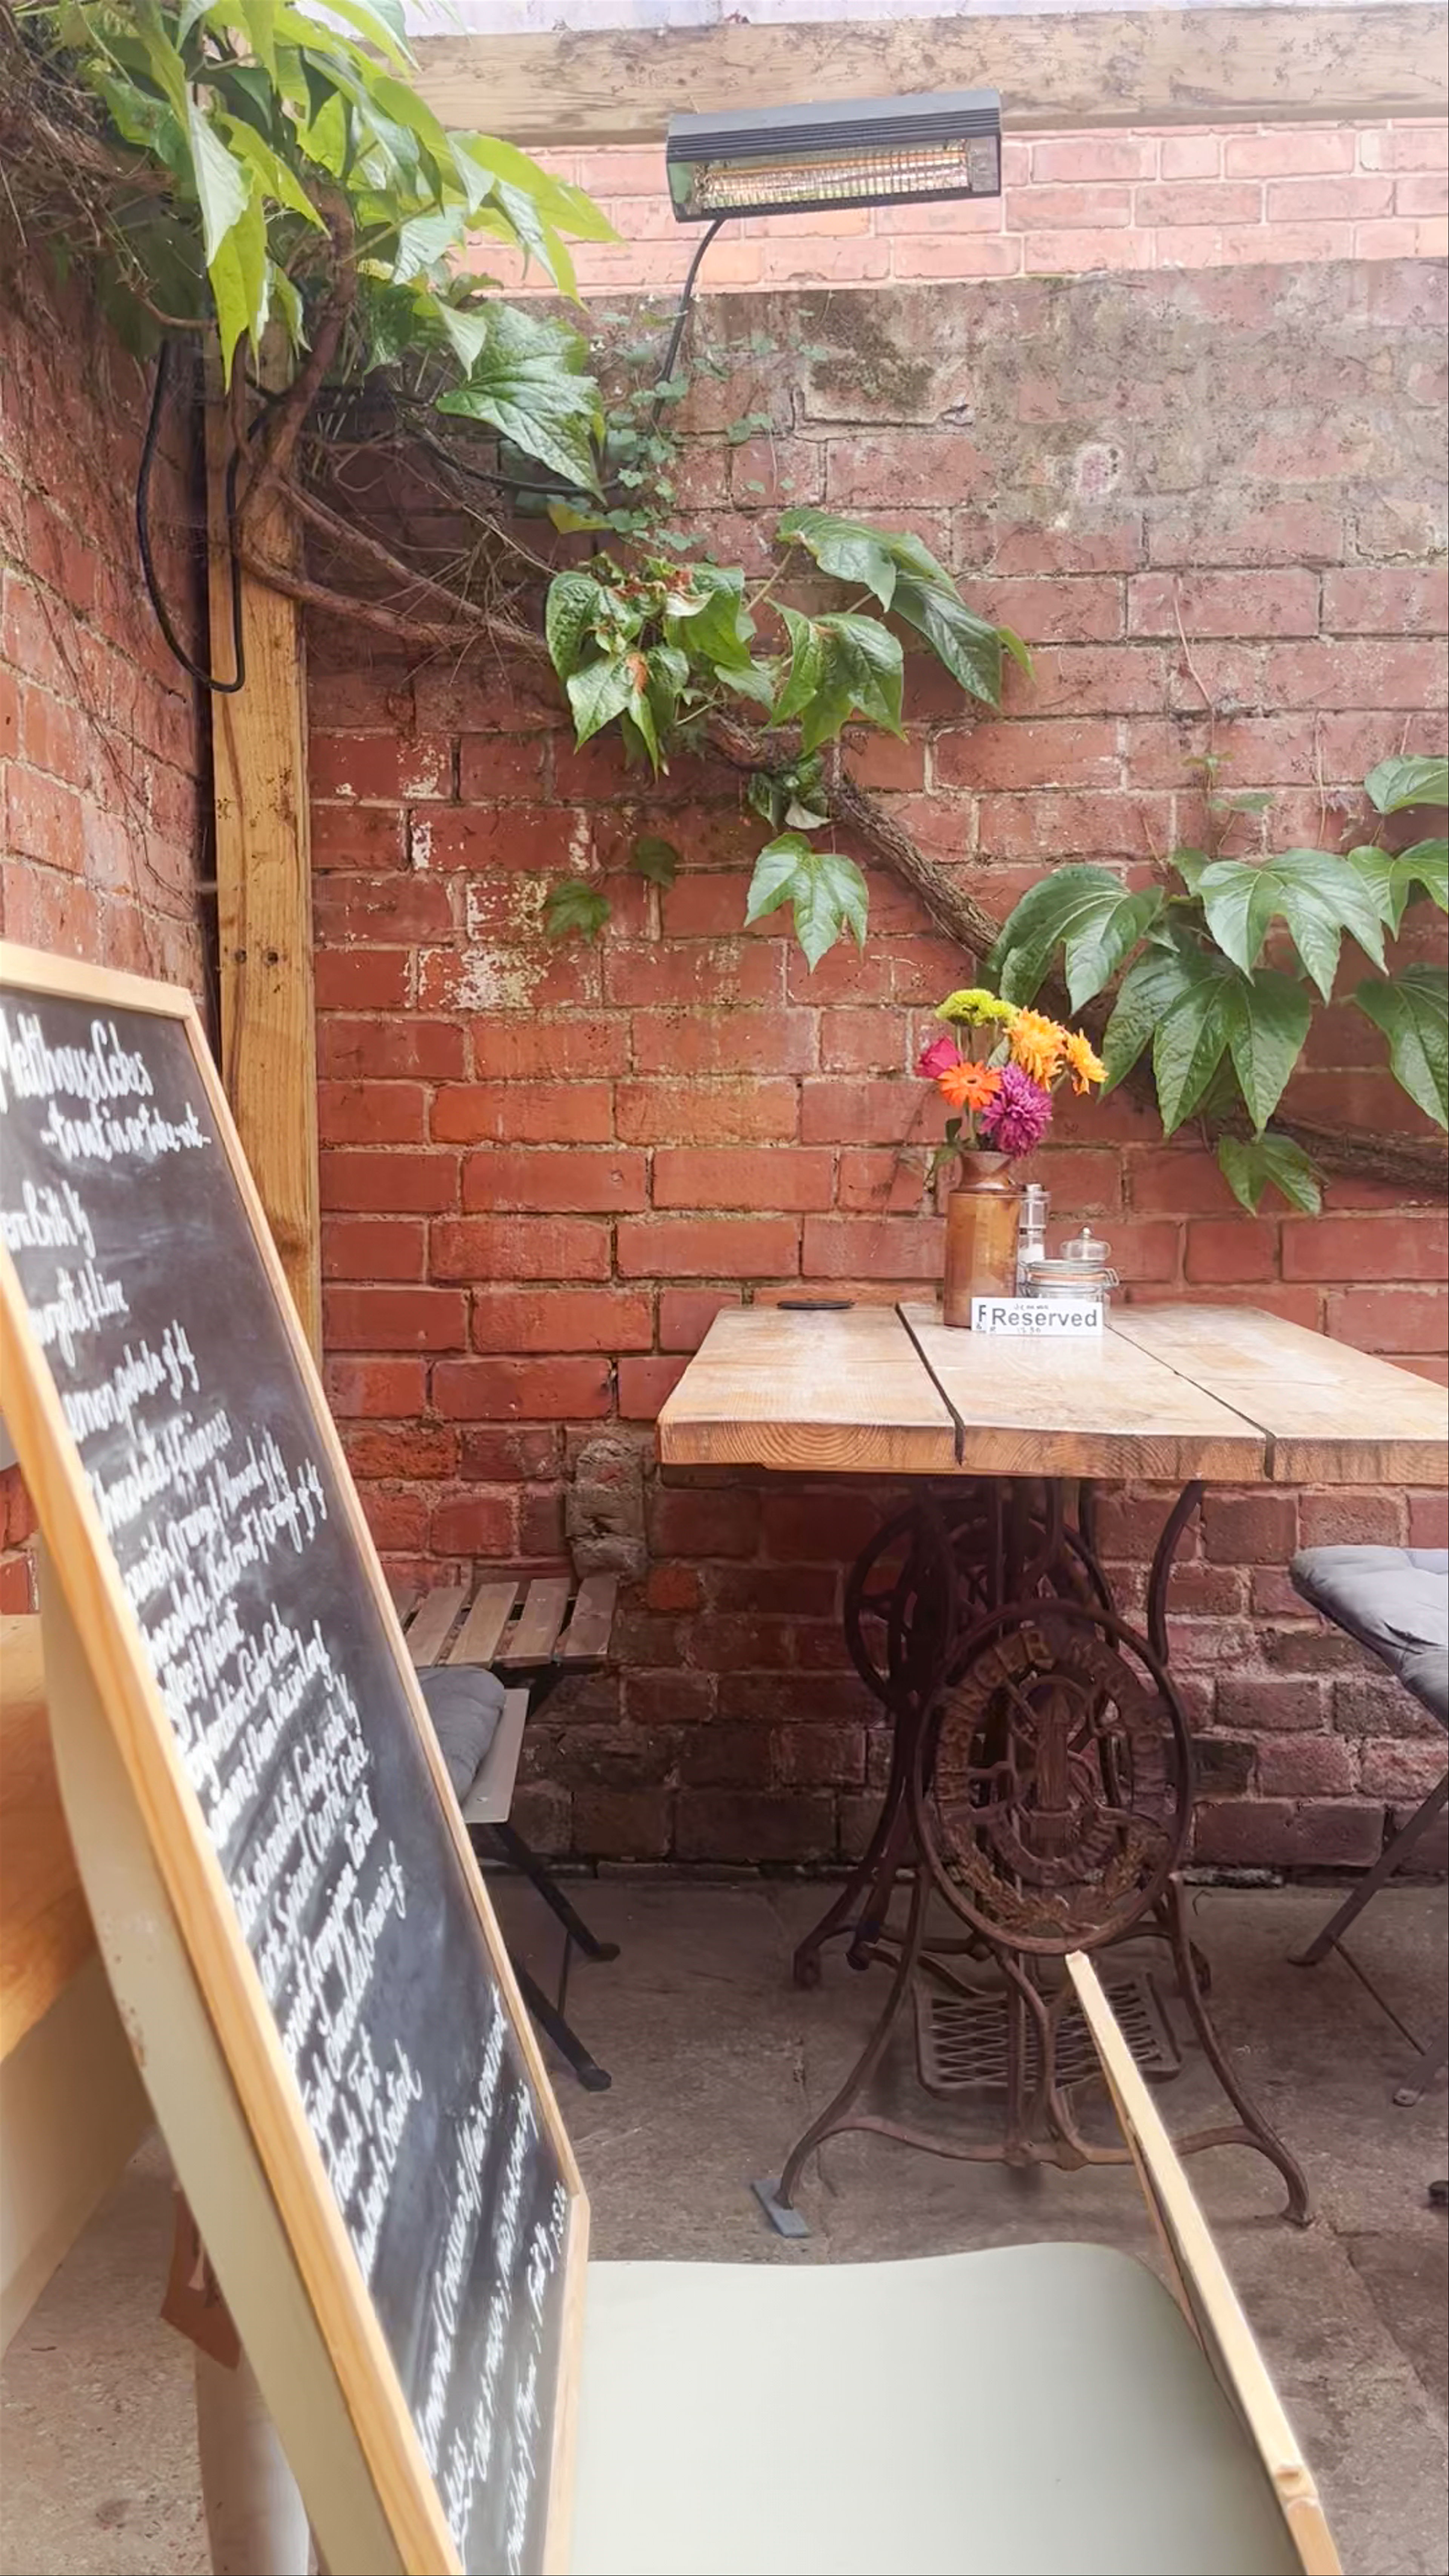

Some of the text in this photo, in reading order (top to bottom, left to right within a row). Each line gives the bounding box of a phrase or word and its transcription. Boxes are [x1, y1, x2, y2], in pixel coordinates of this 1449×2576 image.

[92, 1021, 153, 1097] Cakes
[75, 1100, 112, 1161] eat
[102, 1106, 130, 1153] in
[0, 1212, 36, 1250] ara
[27, 1268, 90, 1368] ourgette
[85, 1258, 129, 1316] Lime
[992, 1308, 1097, 1327] Reserved
[63, 1384, 124, 1441] emon
[116, 1341, 166, 1443] polenta
[89, 1421, 170, 1532] hocolate
[121, 1522, 175, 1611] panish
[216, 1437, 261, 1515] Almond
[160, 1662, 200, 1750] offee
[238, 1637, 271, 1706] Cider
[264, 1603, 295, 1665] Cake
[938, 1629, 1056, 1746] SINGER
[205, 1769, 252, 1855] anana
[248, 1718, 278, 1773] Rum
[294, 1620, 337, 1691] Loaf
[229, 1869, 260, 1940] ich
[260, 1912, 290, 2005] ark
[283, 1950, 313, 2075] pricot
[328, 2025, 381, 2213] reacle Tart
[352, 2147, 389, 2284] hubarb
